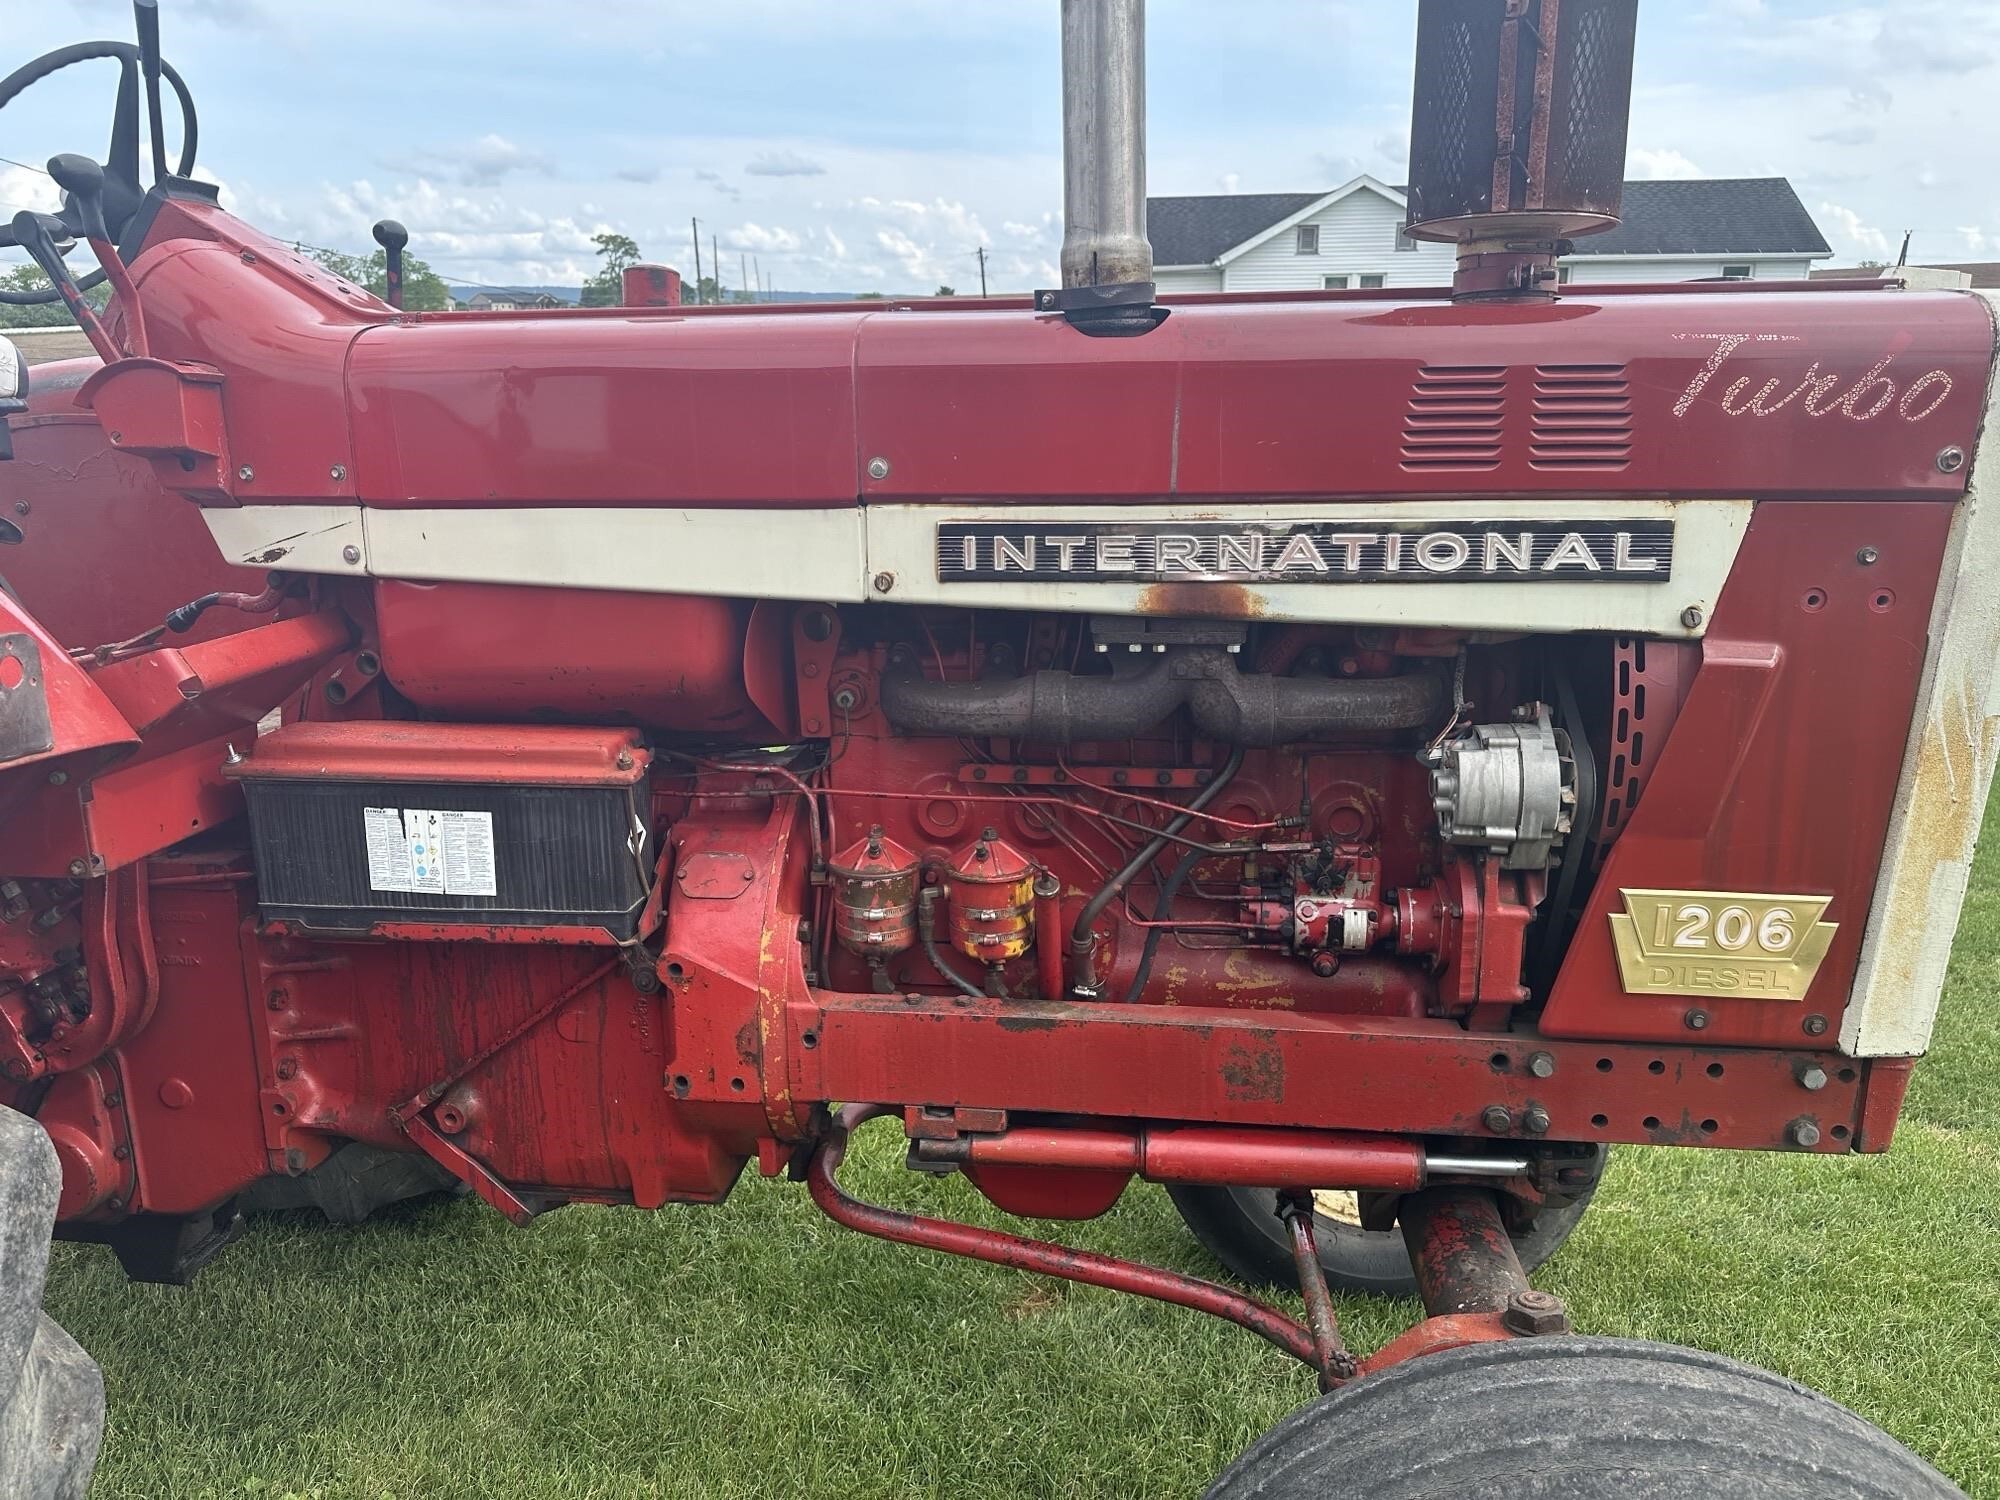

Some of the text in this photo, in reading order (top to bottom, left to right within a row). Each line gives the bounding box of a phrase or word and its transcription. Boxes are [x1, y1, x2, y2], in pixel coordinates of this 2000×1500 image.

[1672, 332, 1953, 422] Turbo
[963, 532, 1658, 572] INTERNATIONAL
[1653, 904, 1797, 952] 1206
[1648, 965, 1790, 991] DIESEL
